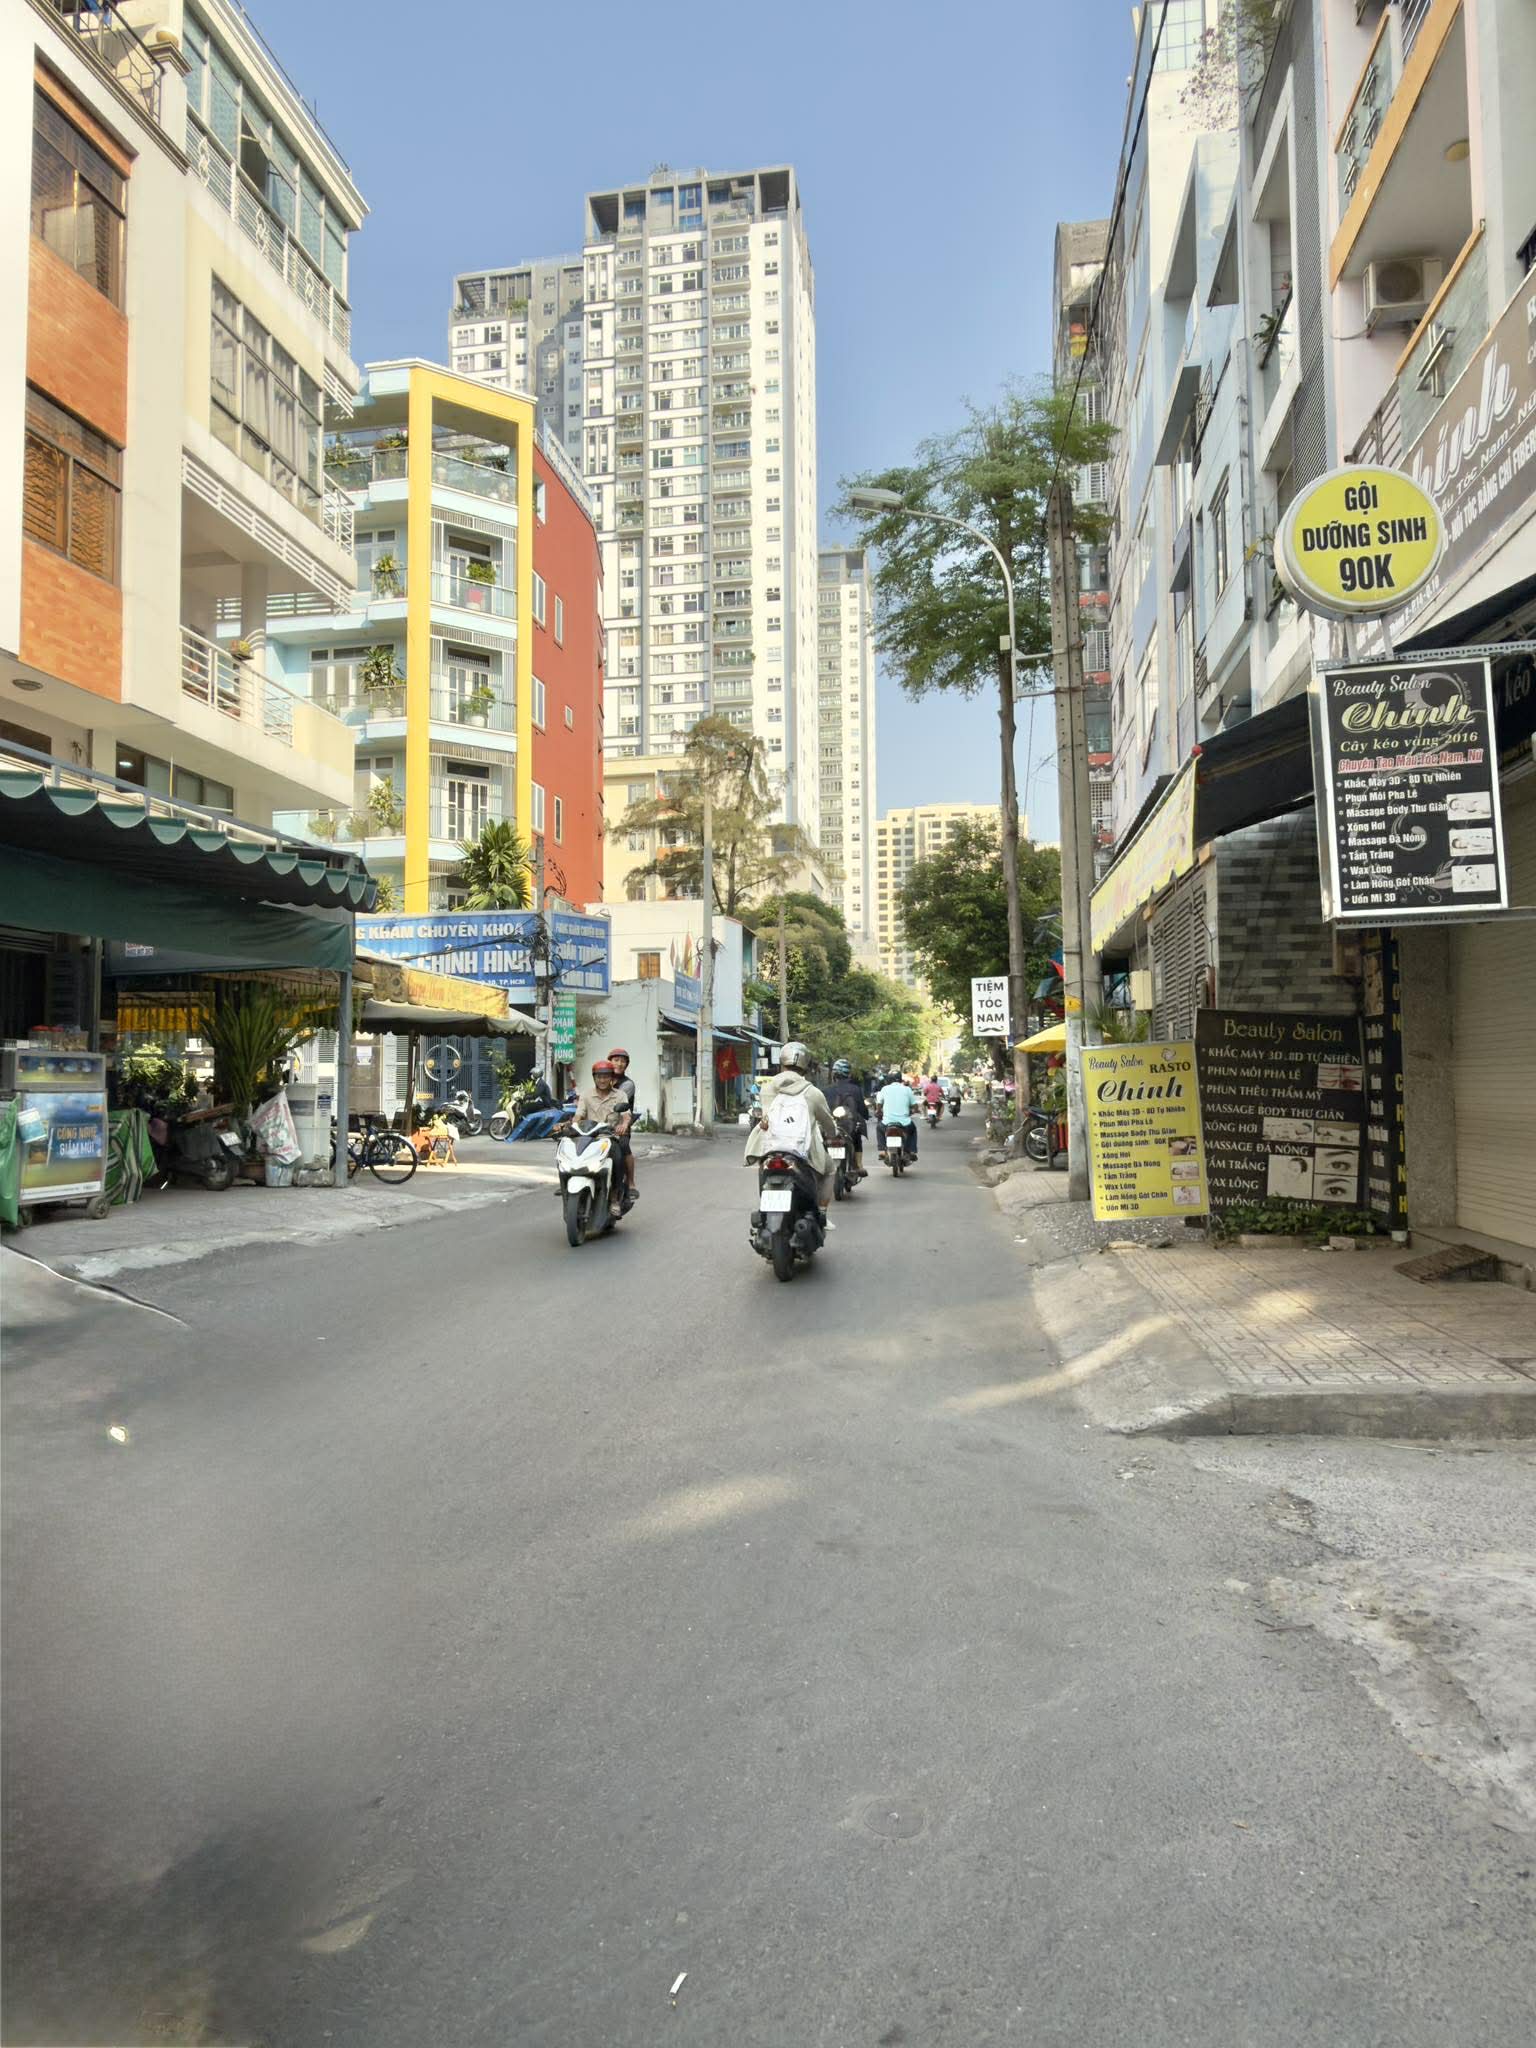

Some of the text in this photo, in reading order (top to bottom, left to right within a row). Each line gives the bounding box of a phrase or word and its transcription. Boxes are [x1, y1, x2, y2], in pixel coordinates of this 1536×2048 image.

[1410, 340, 1517, 498] hính
[1344, 480, 1378, 515] GỘI
[1302, 520, 1371, 552] DƯỠNG
[1377, 517, 1427, 545] SINH
[1339, 553, 1395, 592] 90K
[1333, 673, 1432, 699] Beauty Salon
[1341, 694, 1476, 733] Chính
[1340, 732, 1478, 754] Cây kéo vàng 2016
[1338, 758, 1375, 773] Chuyên
[1389, 776, 1400, 785] 3D
[1408, 774, 1420, 784] 8D
[1422, 773, 1433, 784] Tự
[1435, 771, 1461, 782] Nhiên
[1345, 793, 1367, 803] Phun
[1369, 791, 1386, 801] Môi
[1388, 790, 1405, 800] Pha
[1346, 807, 1385, 818] Massage
[1387, 805, 1409, 815] Body
[1410, 803, 1427, 813] Thư
[1348, 836, 1387, 847] Massage
[1350, 865, 1369, 876] Wax
[1412, 874, 1435, 886] Chân
[1371, 892, 1382, 903] Mi
[1384, 892, 1396, 902] 3D
[417, 921, 478, 938] CHUYÊN
[482, 922, 524, 937] KHOA
[483, 944, 532, 974] HÌNH
[976, 979, 1004, 993] TIỆM
[978, 996, 1002, 1008] TÓC
[977, 1012, 1004, 1022] NAM
[556, 1029, 573, 1044] UỐC
[1223, 1018, 1343, 1044] Beauty Salon
[1208, 1045, 1238, 1059] KHẮC
[1268, 1050, 1282, 1061] 3D
[1307, 1050, 1321, 1064] TỰ
[1323, 1052, 1361, 1065] NHIÊN
[1089, 1054, 1144, 1073] Beauty Salon
[1150, 1061, 1191, 1074] RASTO
[1207, 1065, 1301, 1080] PHUN MÔI PHA LÊ
[1097, 1076, 1183, 1102] Chính
[1206, 1084, 1237, 1096] PHUN
[1239, 1083, 1268, 1097] THÊU
[1206, 1103, 1255, 1115] MASSAGE
[1258, 1106, 1287, 1117] BODY
[1291, 1107, 1314, 1119] THƯ
[1204, 1119, 1258, 1133] XÔNG HƠI
[1100, 1130, 1129, 1139] Massage
[1204, 1140, 1253, 1152] MASSAGE
[1275, 1143, 1309, 1157] NÓNG
[1103, 1161, 1131, 1169] Massage
[1205, 1154, 1266, 1172] ẮM TRẮNG
[1229, 1175, 1259, 1191] LÔNG
